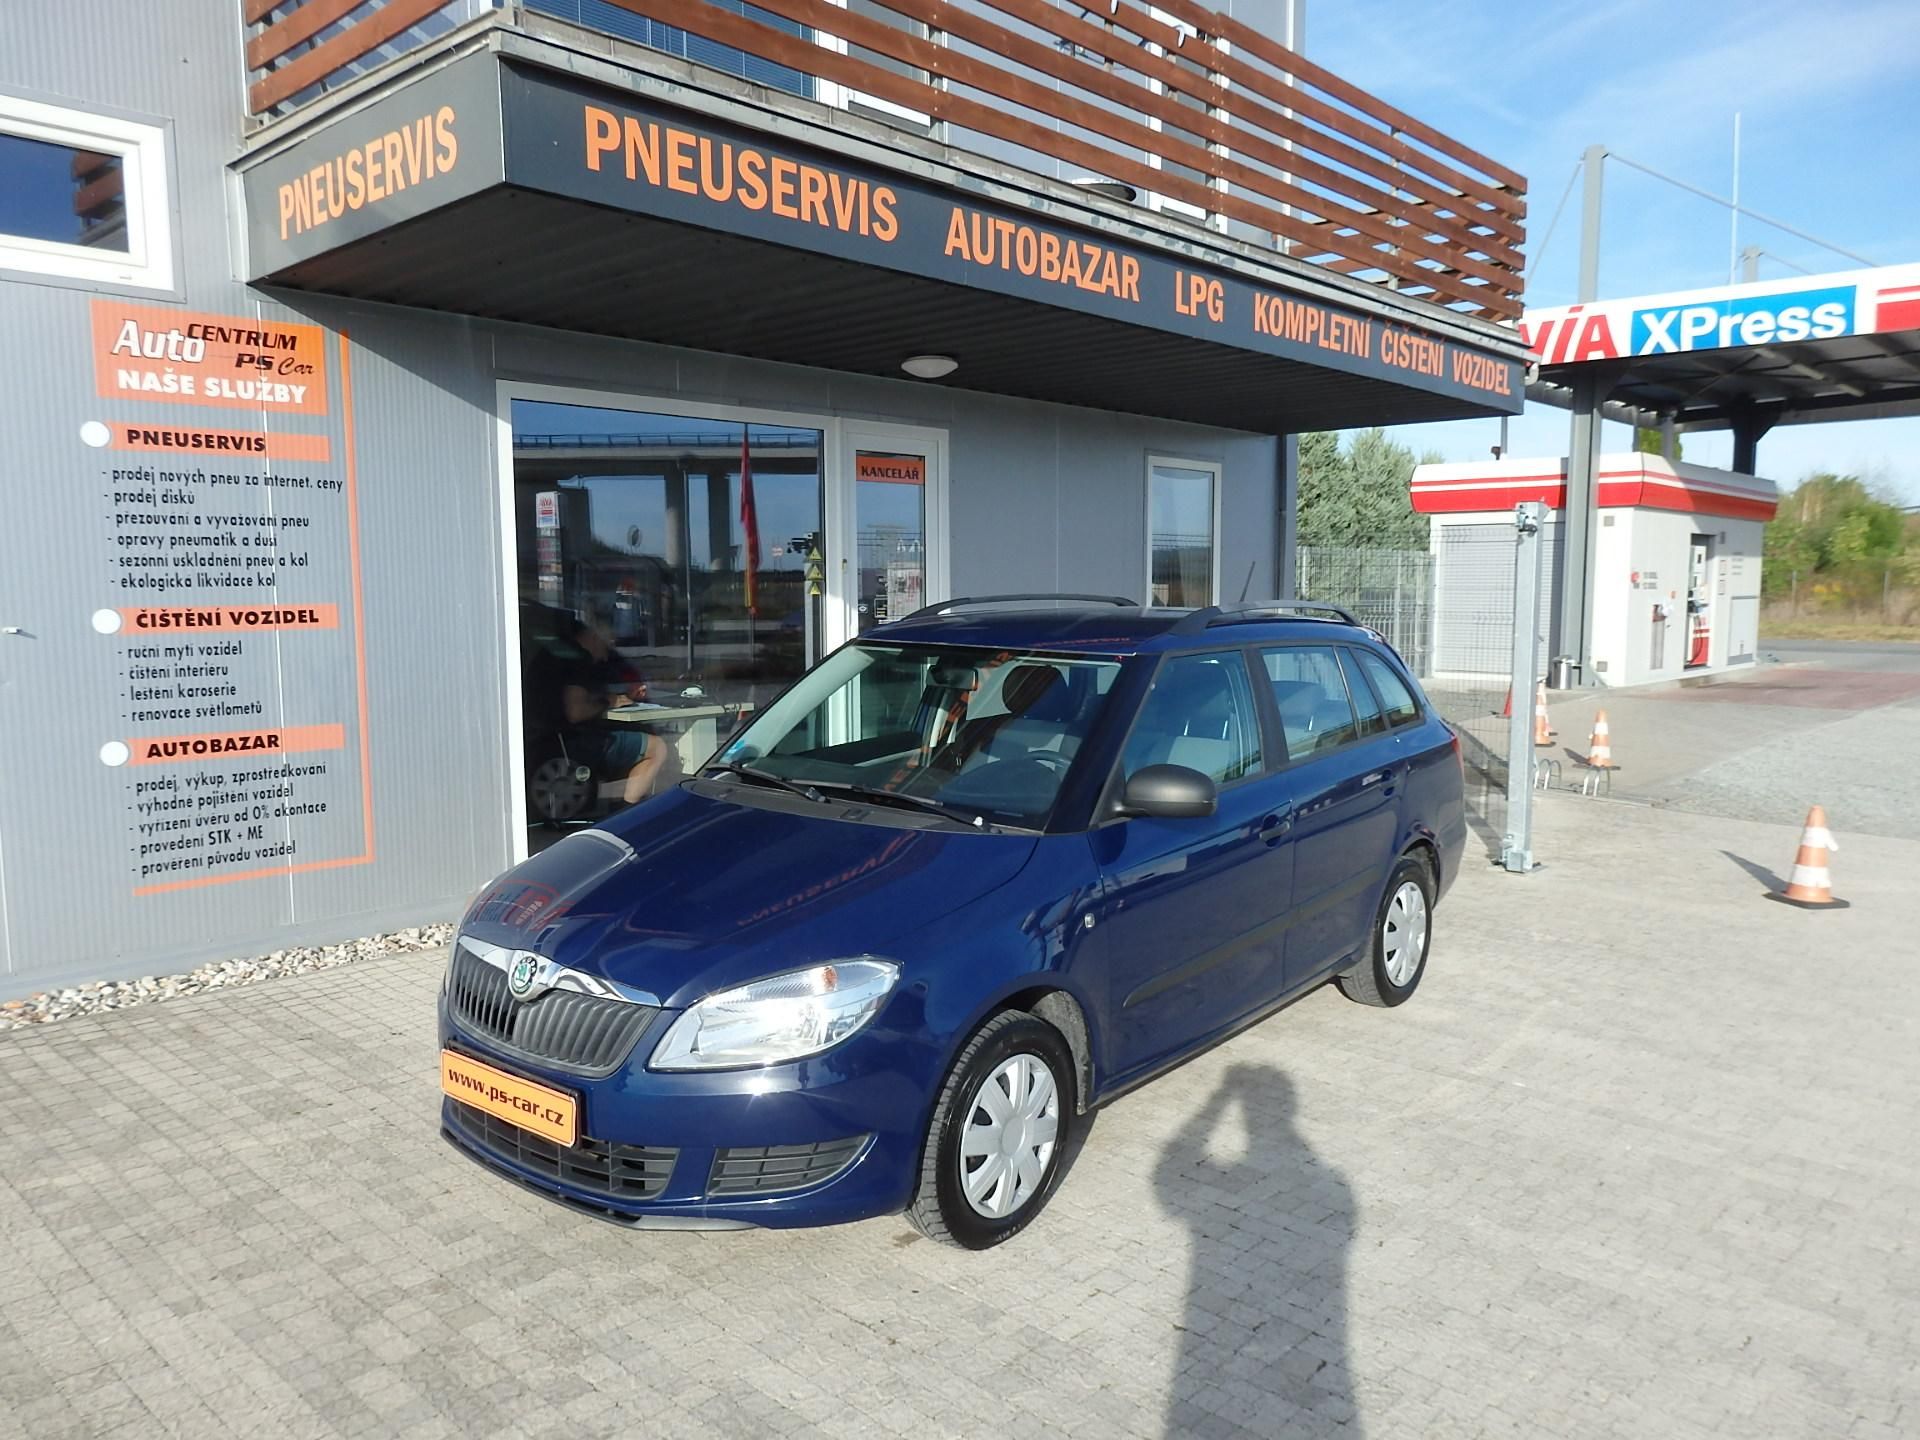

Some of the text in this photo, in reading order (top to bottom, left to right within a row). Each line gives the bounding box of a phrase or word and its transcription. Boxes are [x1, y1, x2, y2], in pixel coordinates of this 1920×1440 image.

[278, 105, 458, 241] PNEUSERVIS
[584, 105, 1512, 396] PNEUSERVIS AUTOBAZAR LPG KOMPLETNÍ ČIŠTĚNÍ VOZIDEL
[111, 318, 298, 363] Auto CENTRUM
[1637, 302, 1848, 356] XPress
[235, 352, 315, 376] PS Car
[117, 367, 307, 404] NAŠE SLUŽBY
[127, 429, 266, 452] PNEUSERVIS
[112, 465, 343, 494] prodej nových pneu za internet. ceny
[861, 464, 919, 480] KANCELÁŘ
[114, 487, 195, 508] prodej disků
[194, 515, 201, 525] a
[281, 516, 310, 530] pneu
[117, 535, 165, 550] opravy
[170, 532, 238, 550] pneumatik
[242, 536, 249, 547] a
[173, 551, 241, 567] uskladnění
[246, 556, 275, 570] pneu
[279, 556, 286, 567] a
[290, 551, 309, 567] kol
[121, 571, 276, 592] ekologická likvidace kol
[135, 607, 320, 629] ČIŠTĚNÍ VOZIDEL
[127, 643, 160, 659] ruční
[198, 640, 243, 656] vozidel
[178, 681, 237, 698] karoserie
[131, 700, 263, 722] renovace světlometů
[146, 734, 280, 759] AUTOBAZAR
[232, 761, 327, 786] zprostředkování
[137, 782, 294, 817] výhodné pojištění vozidel
[234, 806, 249, 822] od
[252, 805, 270, 820] 0%
[274, 802, 327, 818] akontace
[140, 834, 204, 858] provedení
[208, 828, 232, 846] STK
[247, 825, 264, 841] ME
[141, 839, 296, 878] prověření původu vozidel
[448, 1068, 565, 1127] www.ps-car.cz
